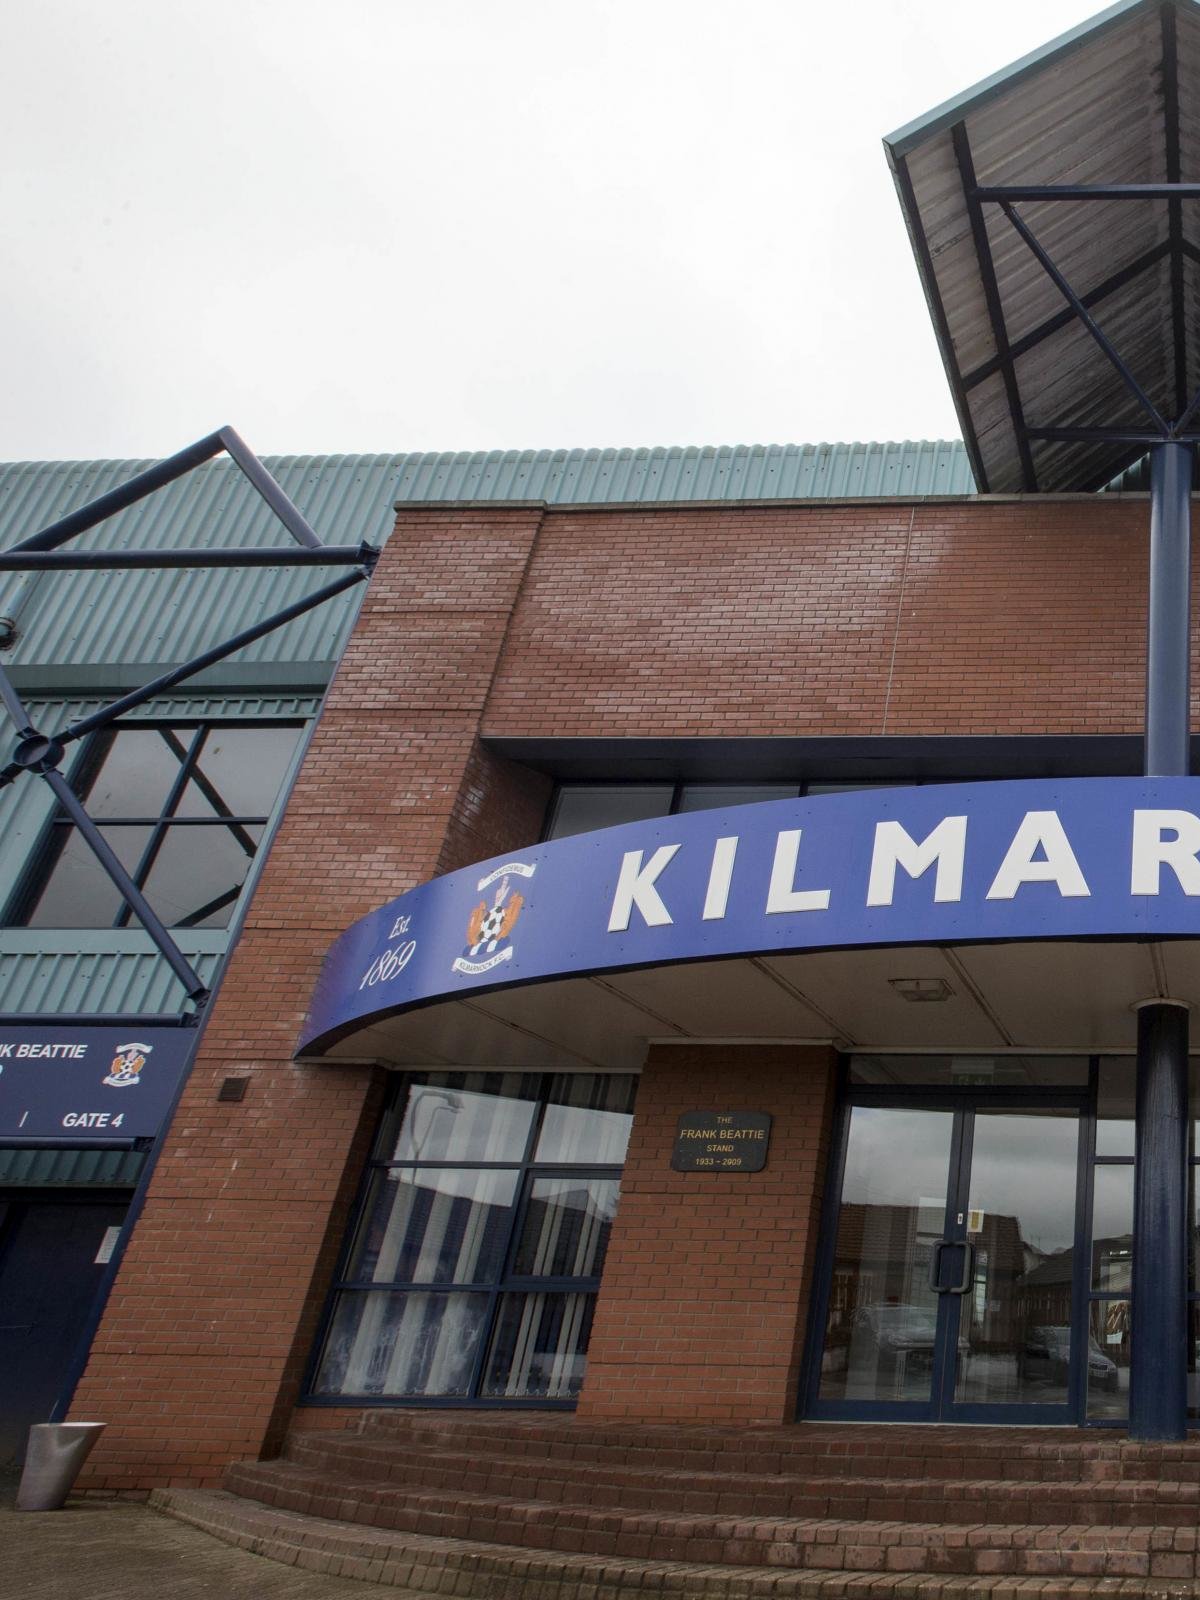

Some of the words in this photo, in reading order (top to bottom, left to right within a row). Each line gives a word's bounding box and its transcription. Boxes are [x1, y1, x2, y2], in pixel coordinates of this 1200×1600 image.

[389, 915, 411, 939] Est.
[359, 940, 417, 991] 1869
[16, 1044, 88, 1058] BEATTIE
[62, 1112, 110, 1128] GATE
[111, 1113, 124, 1128] 4
[716, 1116, 733, 1124] THE
[680, 1129, 717, 1139] FRANK
[719, 1129, 765, 1139] BEATTIE
[706, 1144, 734, 1152] STAND
